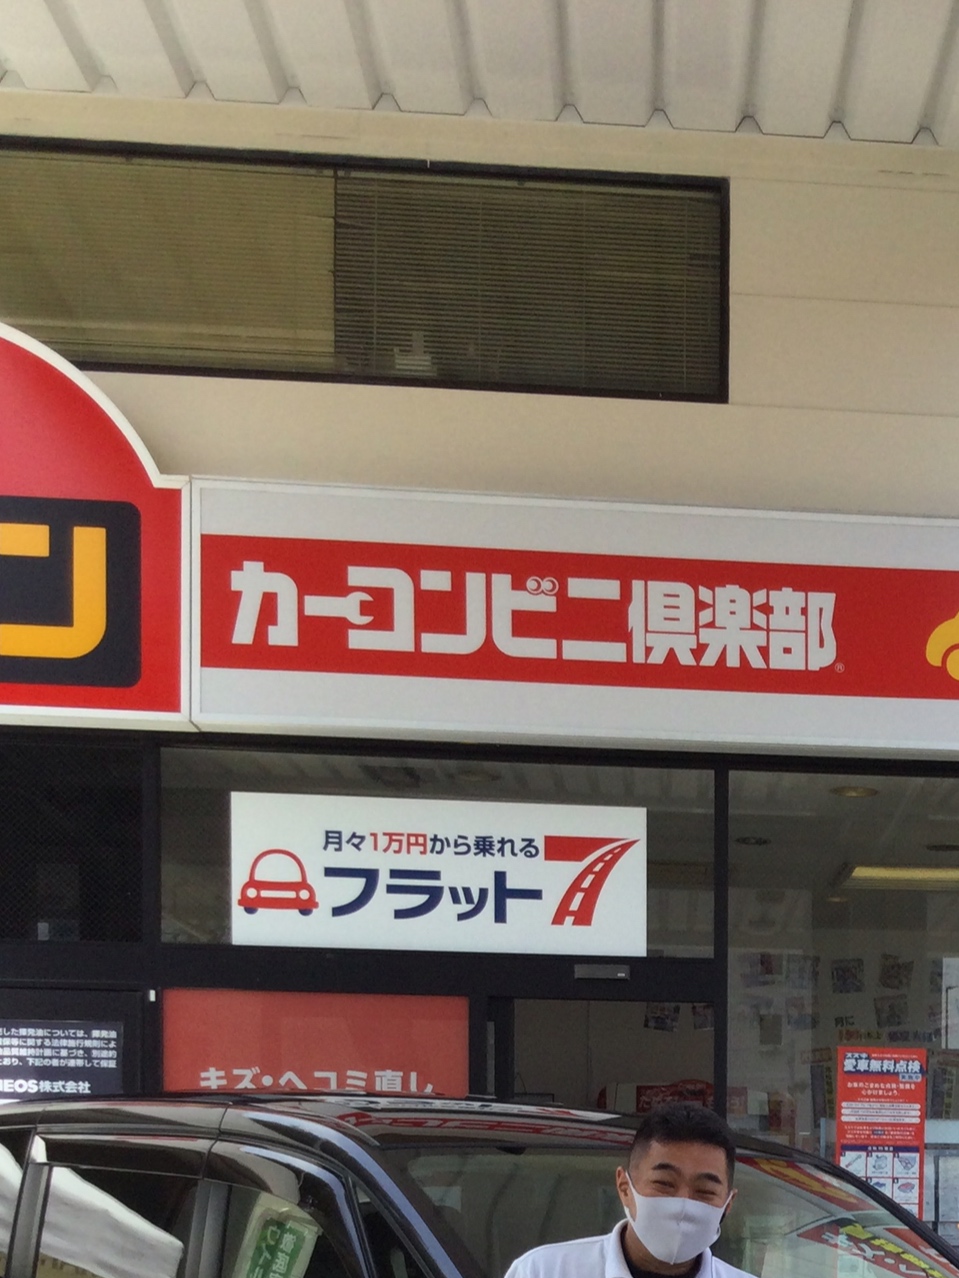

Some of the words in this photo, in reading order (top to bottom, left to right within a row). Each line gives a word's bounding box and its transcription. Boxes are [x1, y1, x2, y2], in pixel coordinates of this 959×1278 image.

[231, 561, 837, 672] カーコンビニ倶楽部
[322, 829, 541, 859] 月々1万円から乗れる
[843, 1059, 921, 1074] 愛車無料点検
[0, 1079, 91, 1094] EOS株式会社
